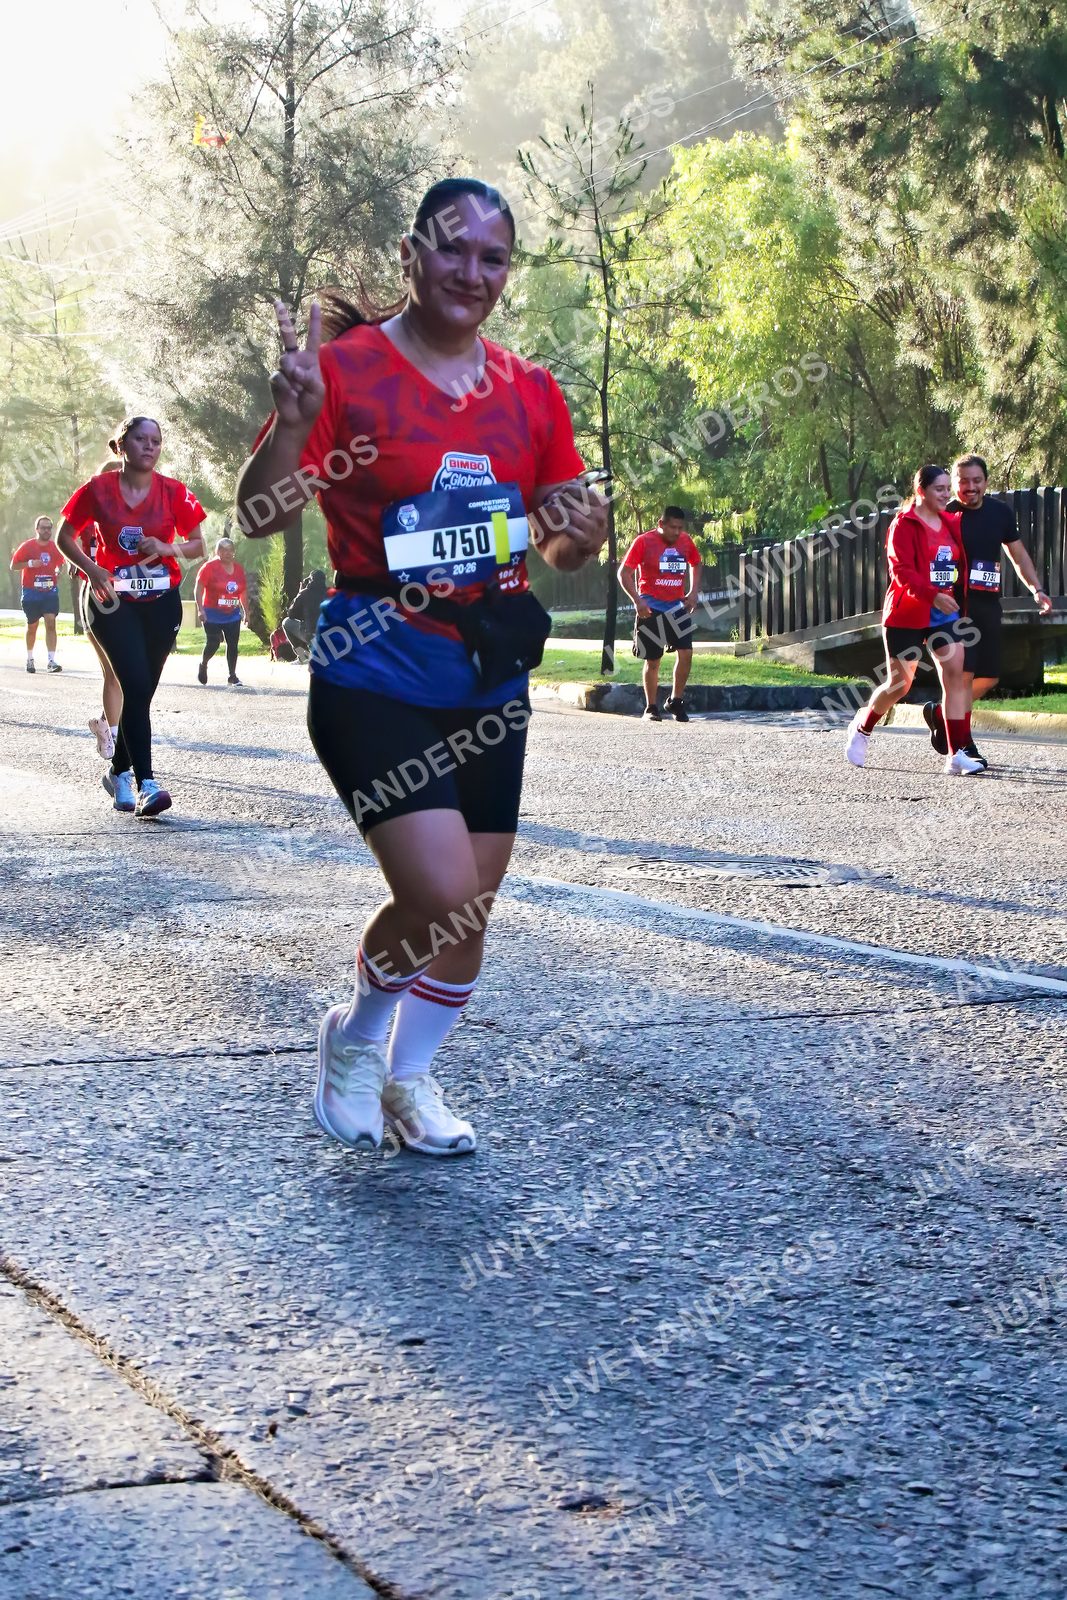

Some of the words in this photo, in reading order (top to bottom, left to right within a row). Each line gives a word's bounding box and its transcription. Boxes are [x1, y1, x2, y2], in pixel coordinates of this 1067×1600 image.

[449, 459, 484, 471] BIMBO
[450, 472, 484, 487] Global
[432, 525, 490, 560] 4750
[130, 579, 154, 590] 4870
